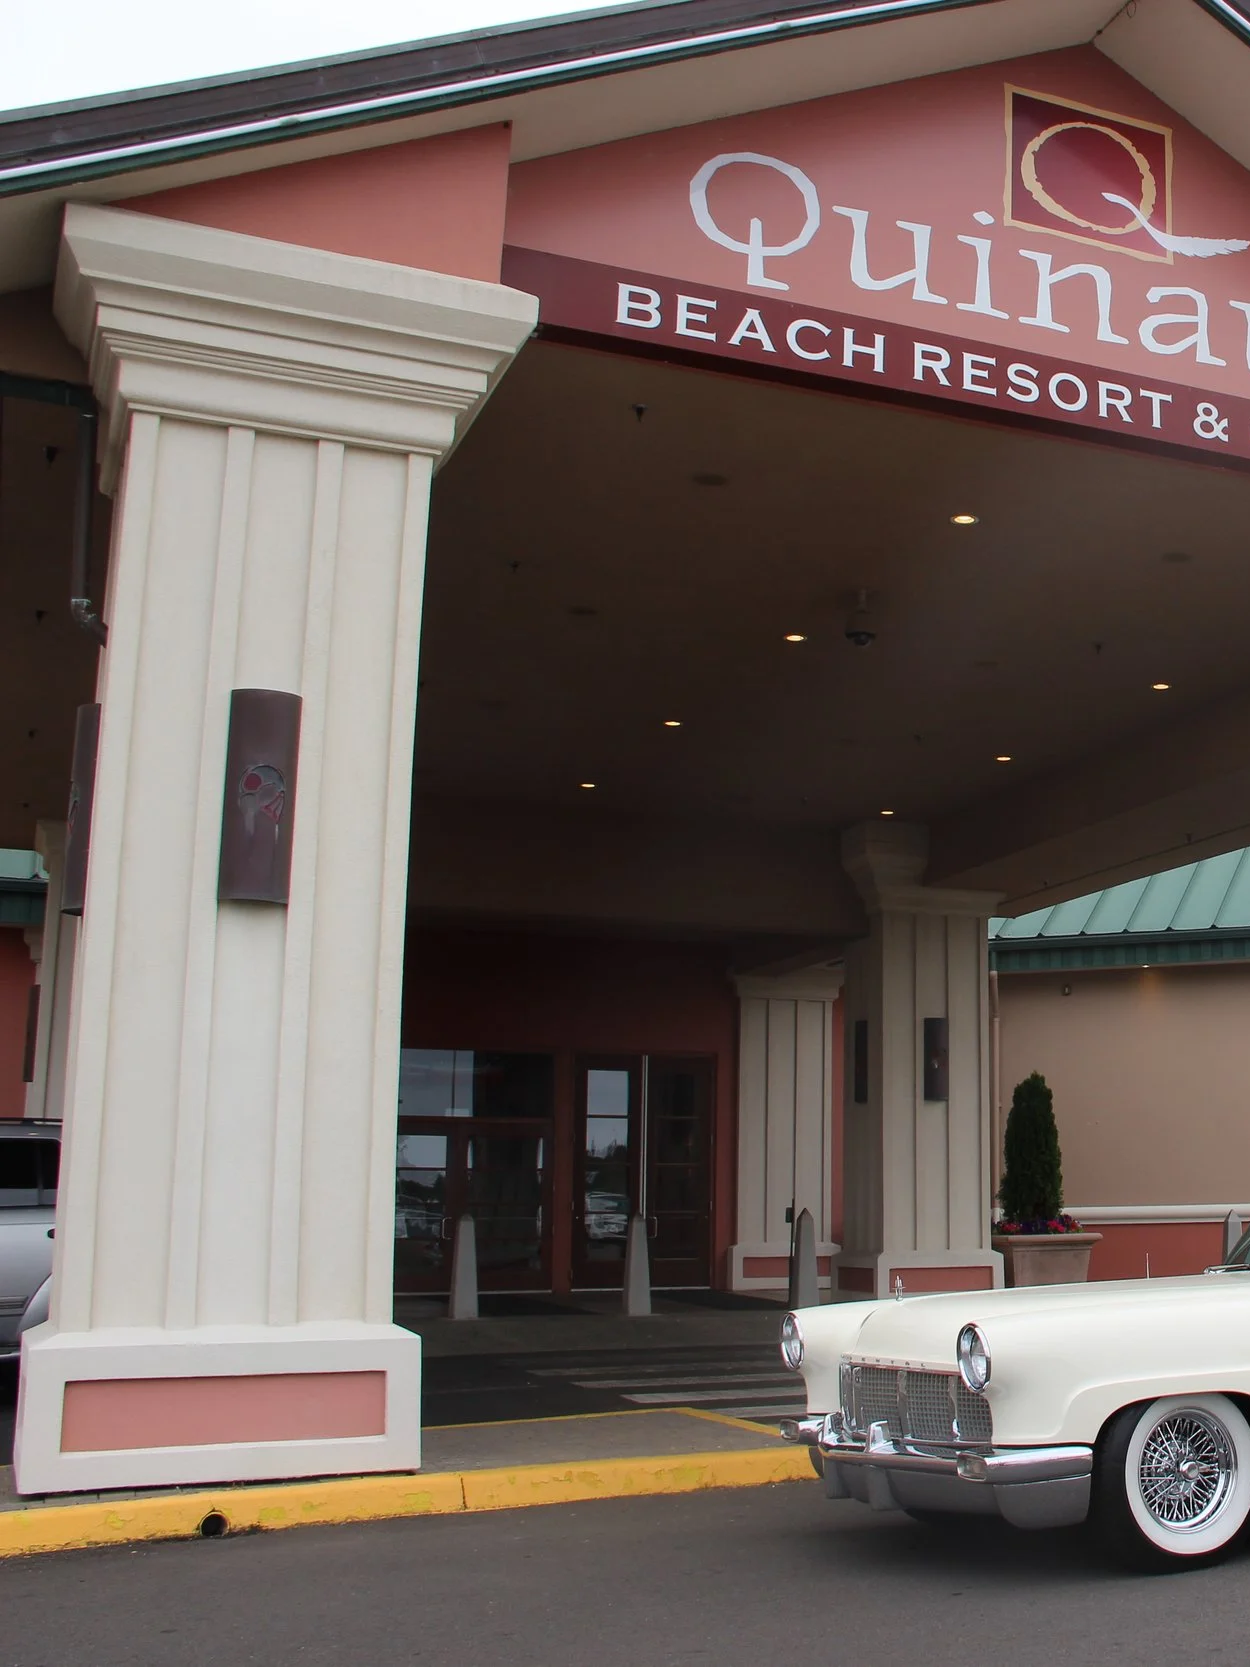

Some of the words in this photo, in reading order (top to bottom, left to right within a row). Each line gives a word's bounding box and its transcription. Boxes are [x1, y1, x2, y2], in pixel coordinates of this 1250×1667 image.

[1020, 121, 1250, 258] Q
[615, 282, 887, 374] BEACH
[912, 341, 1173, 429] RESORT
[1193, 402, 1229, 442] &
